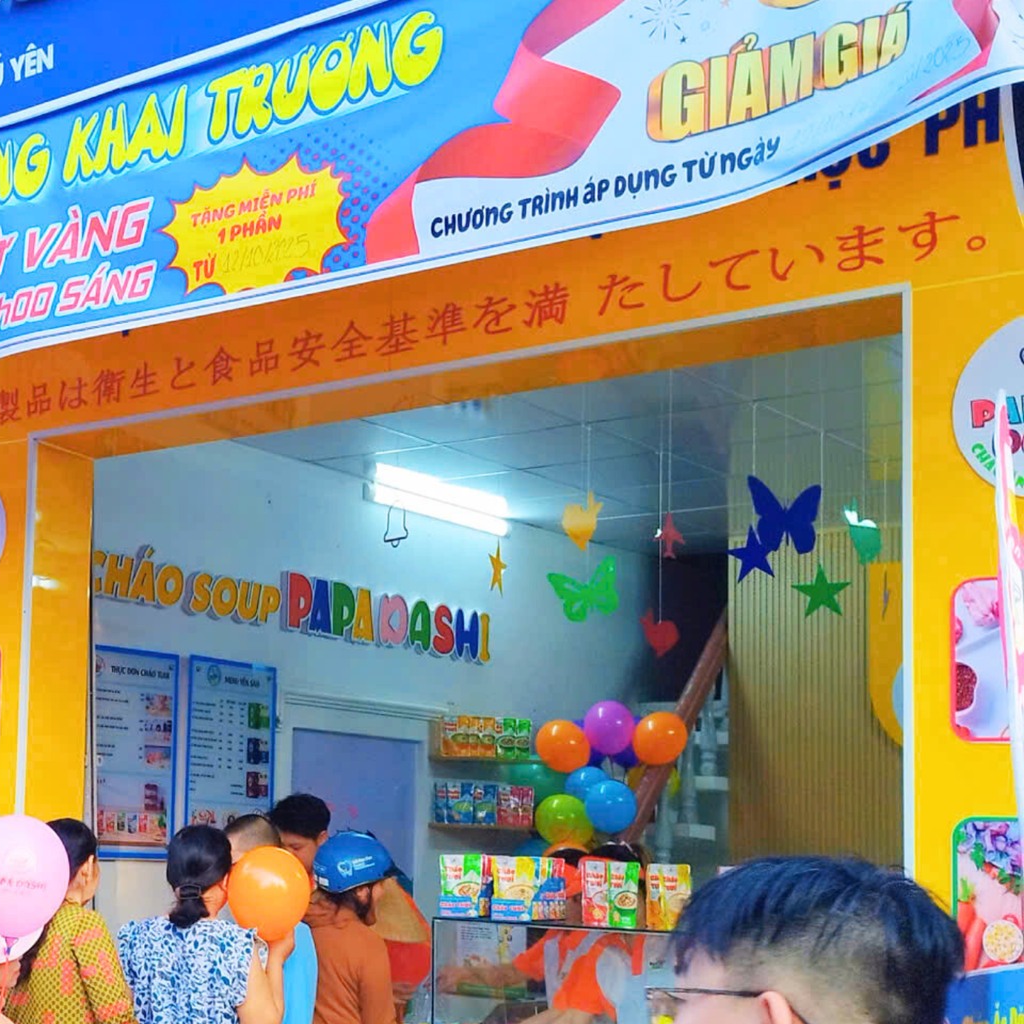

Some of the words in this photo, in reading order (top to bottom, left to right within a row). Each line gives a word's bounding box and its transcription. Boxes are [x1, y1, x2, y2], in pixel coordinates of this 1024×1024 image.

[9, 43, 54, 84] YÊN
[647, 32, 816, 142] GIẢM
[814, 1, 911, 90] GIÁ
[62, 83, 187, 186] KHAI
[207, 11, 443, 144] TRƯƠNG
[24, 199, 154, 273] VÀNG
[191, 204, 235, 228] TẶNG
[238, 189, 283, 215] MIỄN
[286, 179, 317, 203] PHÍ
[218, 228, 226, 244] 1
[230, 211, 282, 241] PHẦN
[58, 261, 156, 320] SÁNG
[193, 253, 216, 281] TỪ
[92, 545, 184, 606] CHÁO
[190, 573, 281, 624] SOUP
[286, 571, 374, 643] PAPA
[378, 594, 490, 663] DASHI
